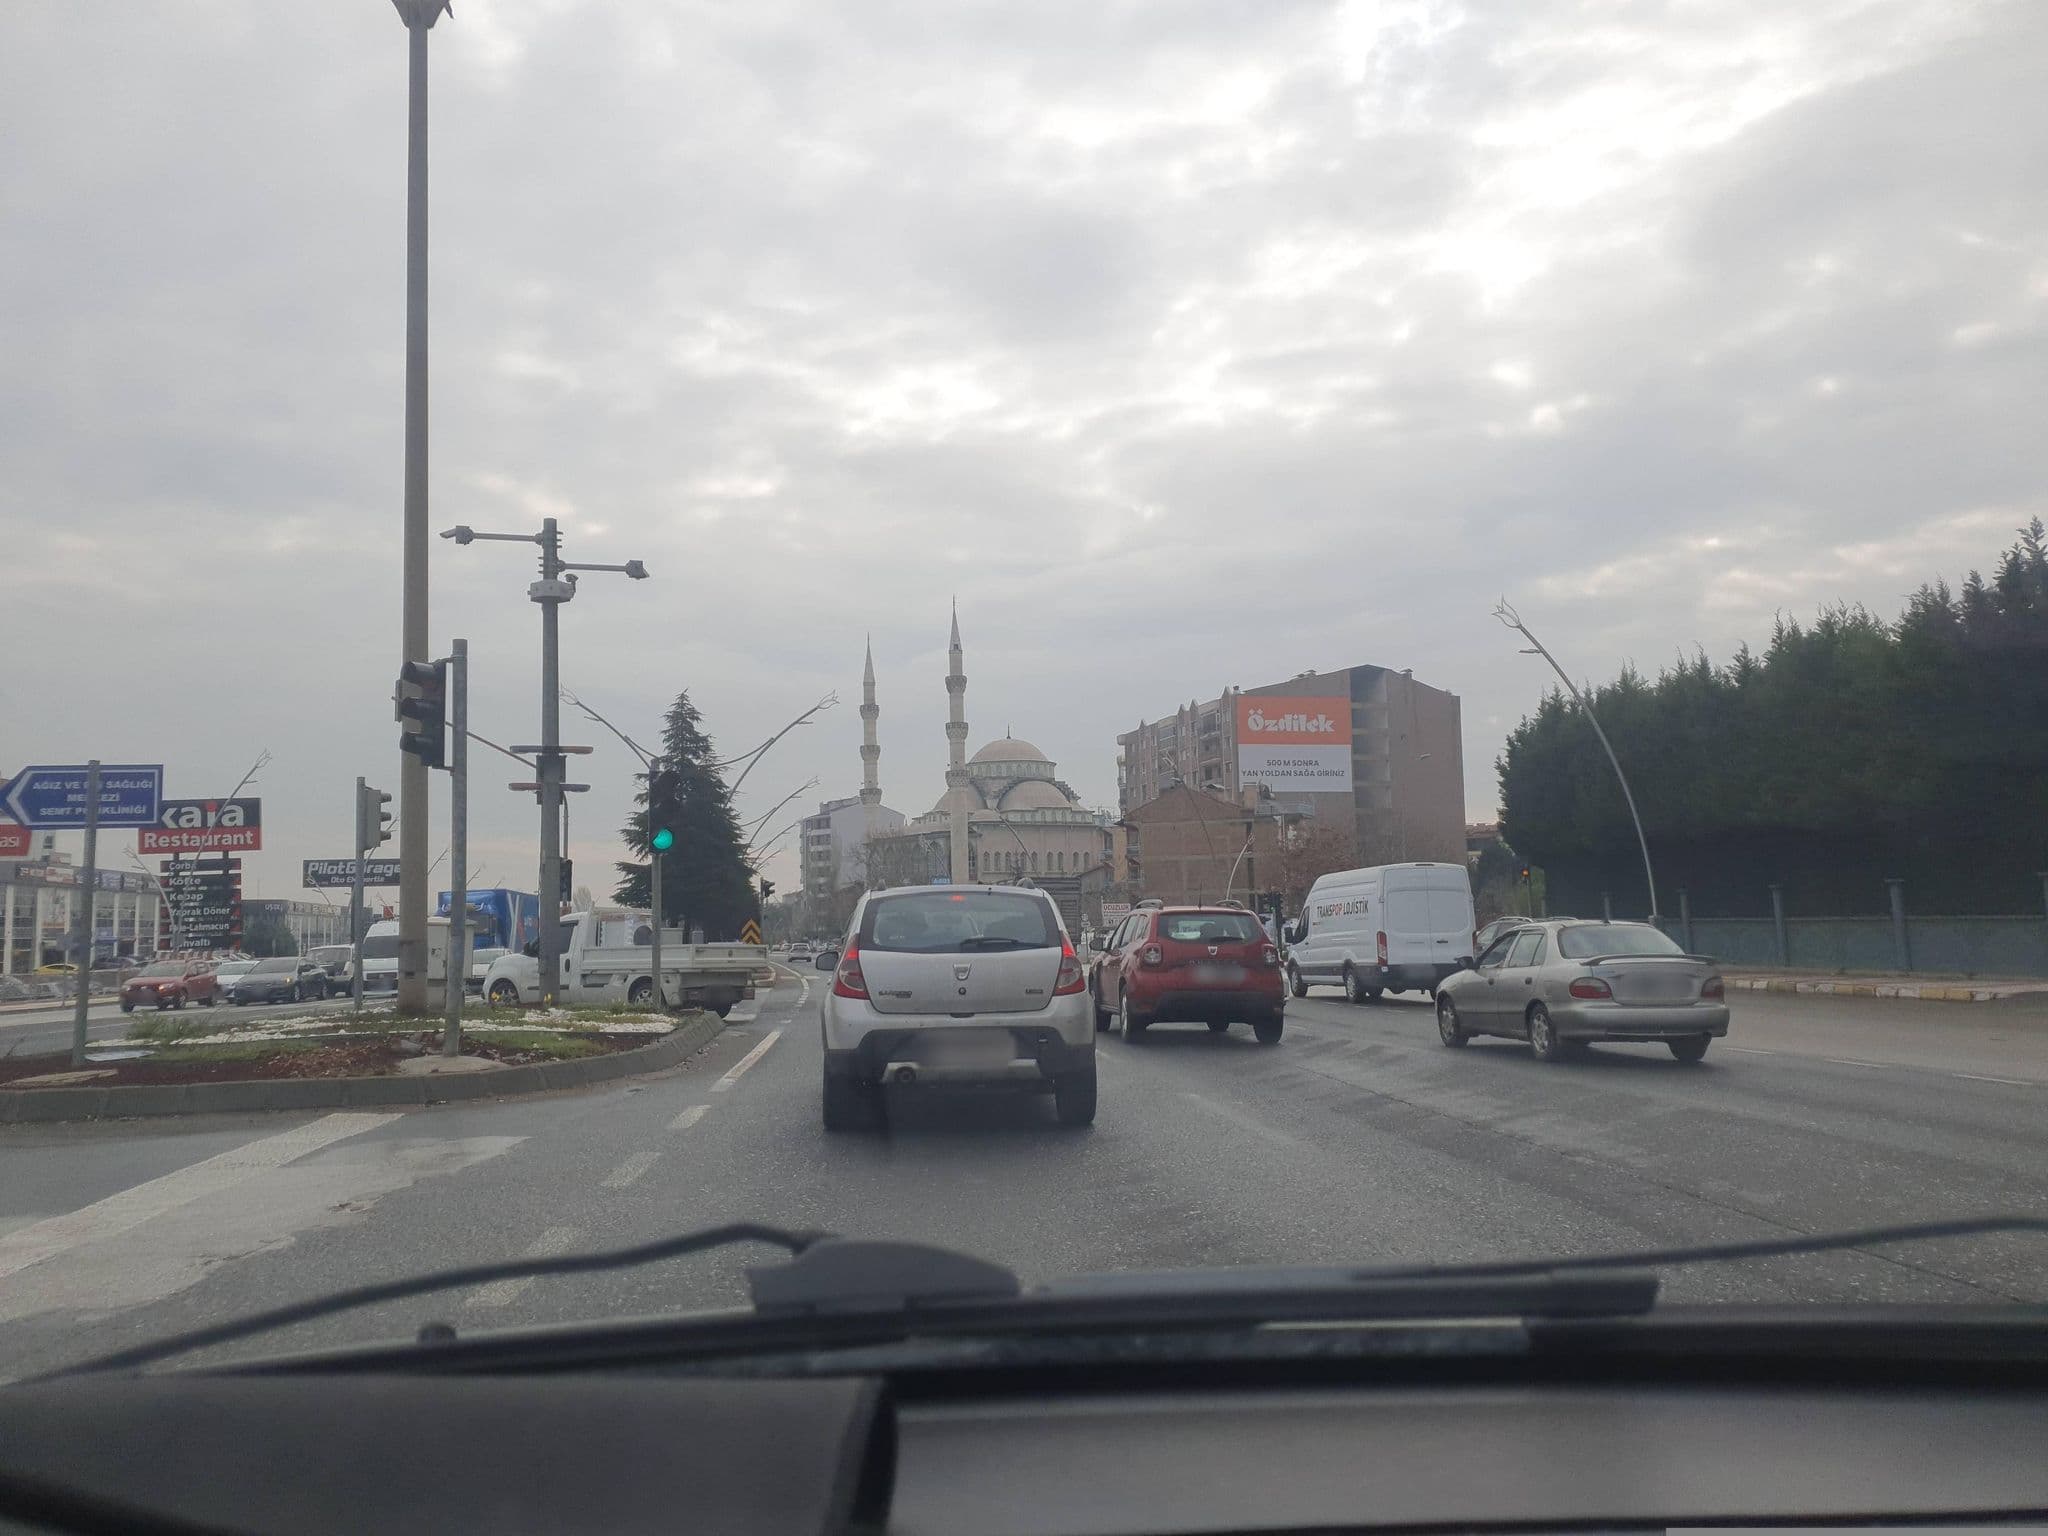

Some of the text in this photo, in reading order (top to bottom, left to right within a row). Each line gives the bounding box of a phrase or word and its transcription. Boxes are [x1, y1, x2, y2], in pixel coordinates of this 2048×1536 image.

[1247, 708, 1335, 732] Özdilek
[1266, 759, 1320, 767] 500 M SONRA
[1293, 769, 1316, 777] SAĞA
[1317, 768, 1345, 777] GİRİNİZ
[64, 781, 80, 790] VE
[105, 779, 153, 789] SAĞLIĞI
[66, 793, 120, 801] MEEZİ
[40, 807, 73, 816] SEMT
[144, 830, 254, 848] Restaurant
[308, 860, 400, 877] PilotGrage
[203, 906, 231, 915] Döner
